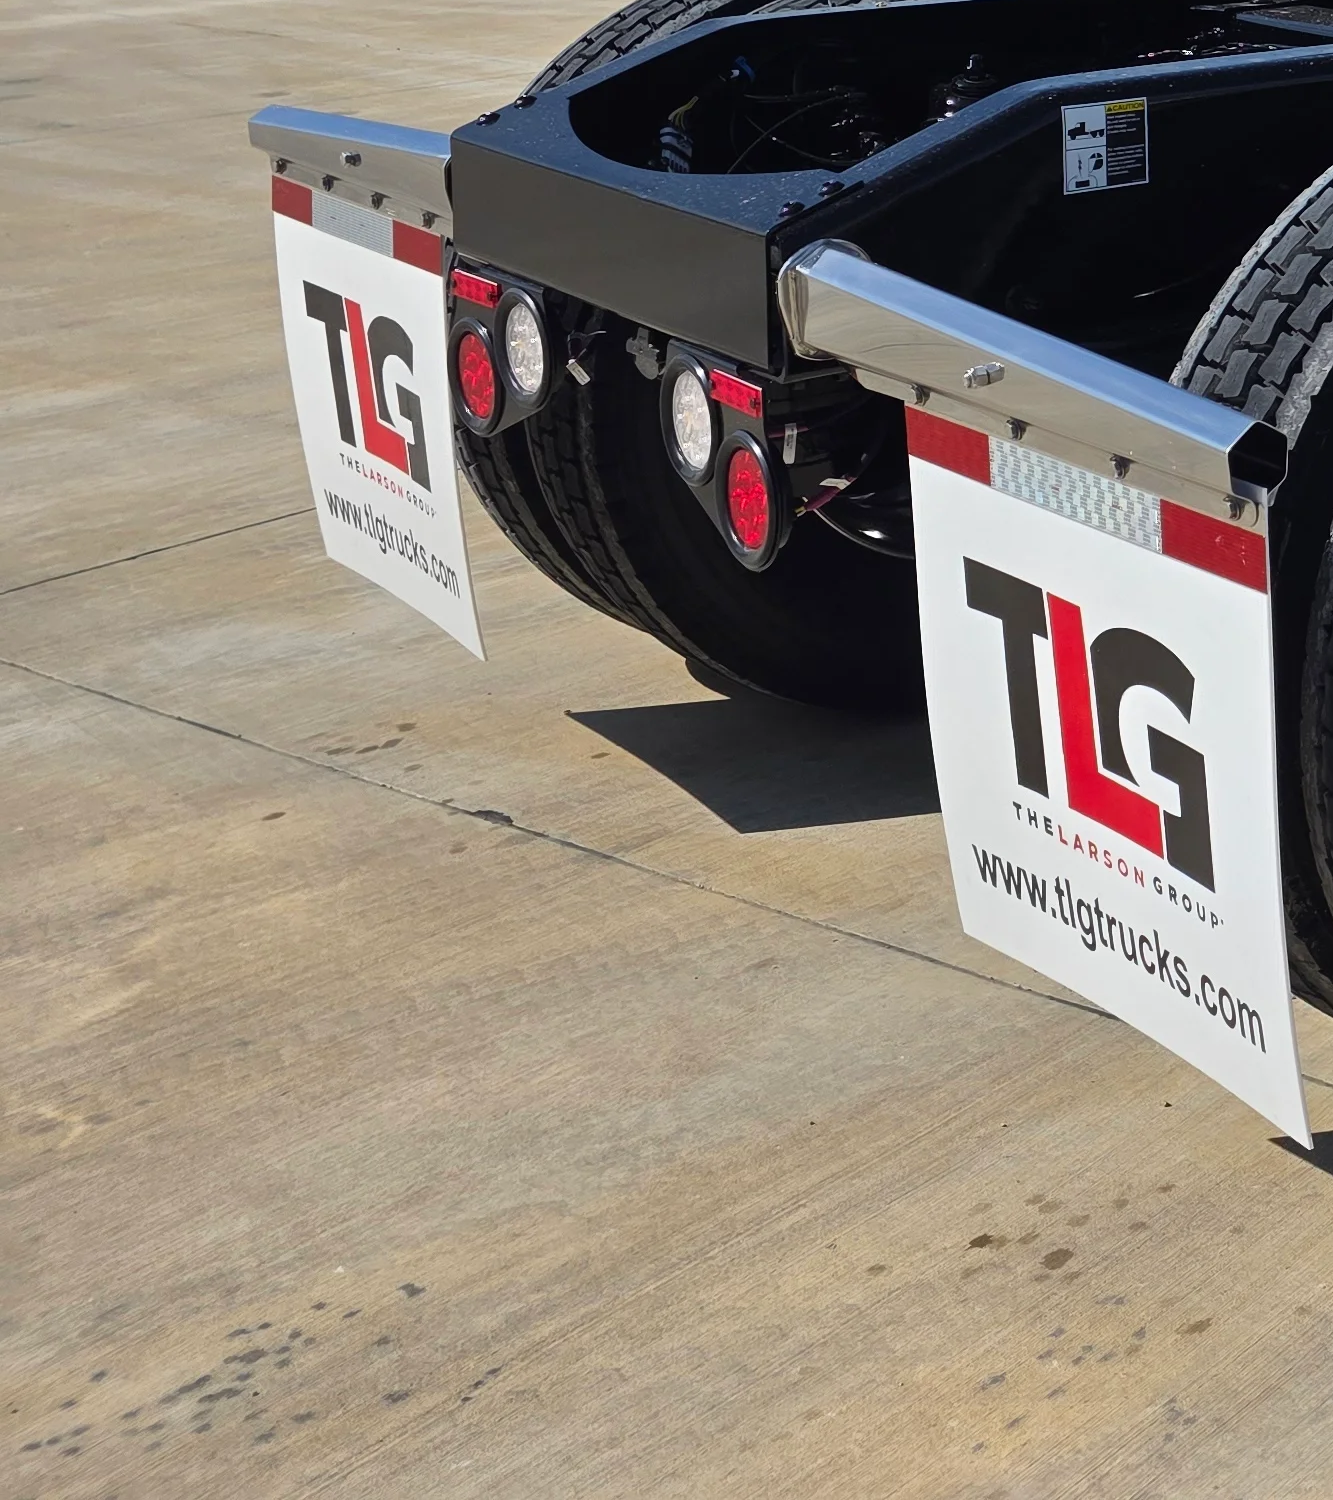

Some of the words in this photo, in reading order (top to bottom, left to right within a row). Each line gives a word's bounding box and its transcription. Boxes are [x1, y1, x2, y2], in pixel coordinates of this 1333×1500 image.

[1112, 101, 1145, 112] CAUTION
[303, 280, 432, 493] TLG
[323, 488, 461, 600] www.tlgtrucks.com
[406, 490, 435, 519] GROUP
[962, 556, 1216, 894] TLG
[971, 844, 1267, 1054] www.tlgtrucks.com
[1152, 876, 1219, 929] GROUP
